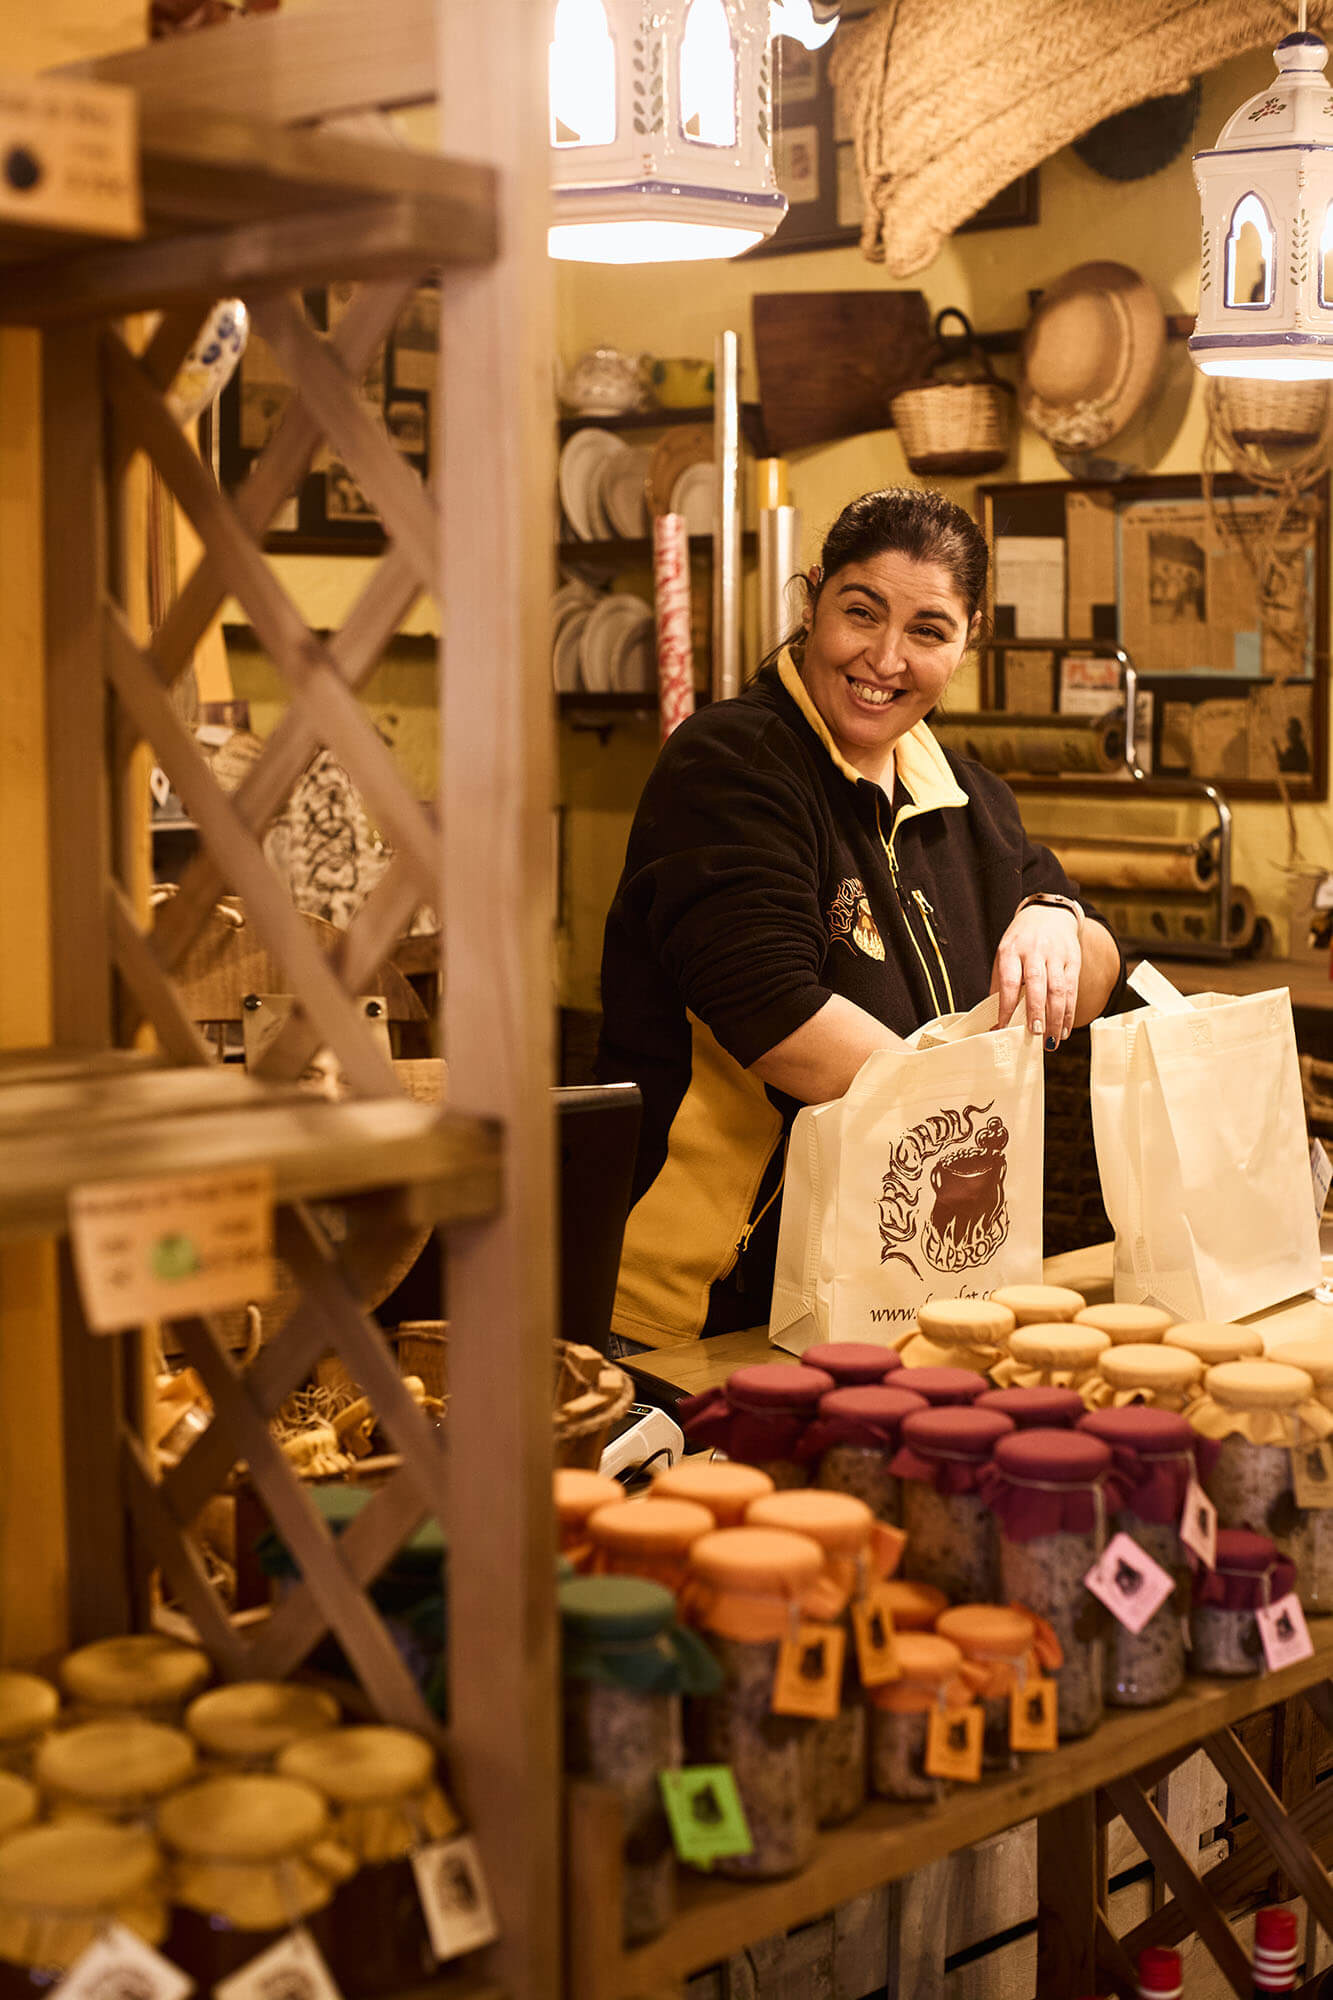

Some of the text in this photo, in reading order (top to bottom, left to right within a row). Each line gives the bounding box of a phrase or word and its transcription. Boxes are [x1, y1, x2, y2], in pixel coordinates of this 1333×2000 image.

[878, 1099, 996, 1281] MERMELADAS
[925, 1208, 1006, 1269] EL PEROLET
